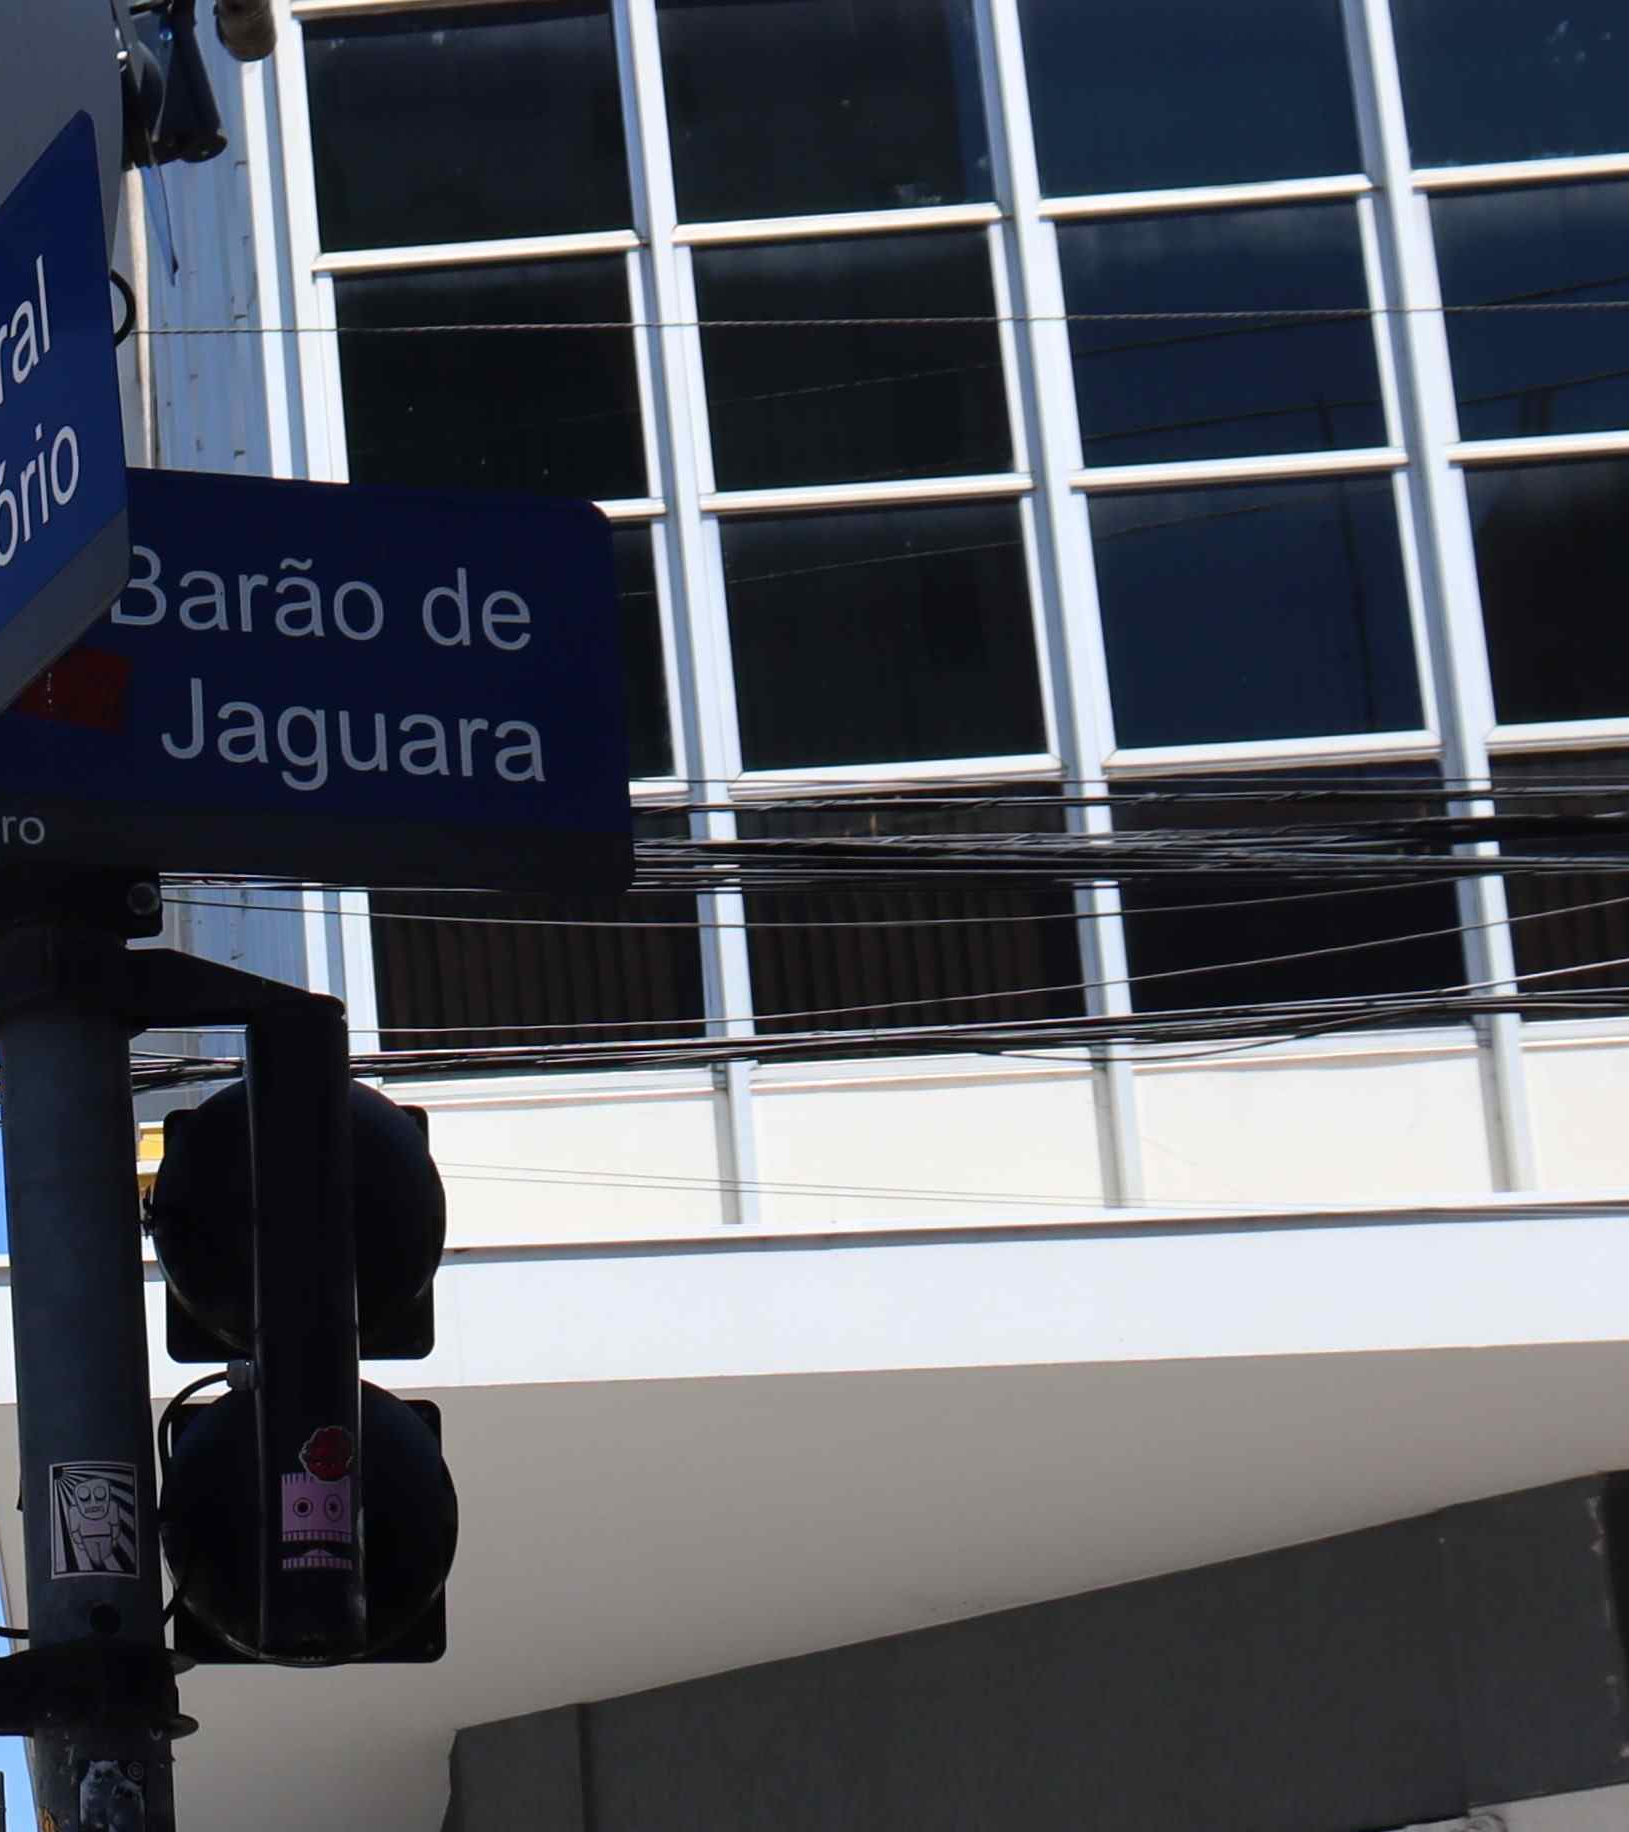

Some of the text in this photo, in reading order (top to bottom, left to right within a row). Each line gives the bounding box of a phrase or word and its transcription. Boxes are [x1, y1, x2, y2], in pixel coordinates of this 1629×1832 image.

[110, 545, 532, 650] Barão de
[160, 677, 546, 791] Jaguara
